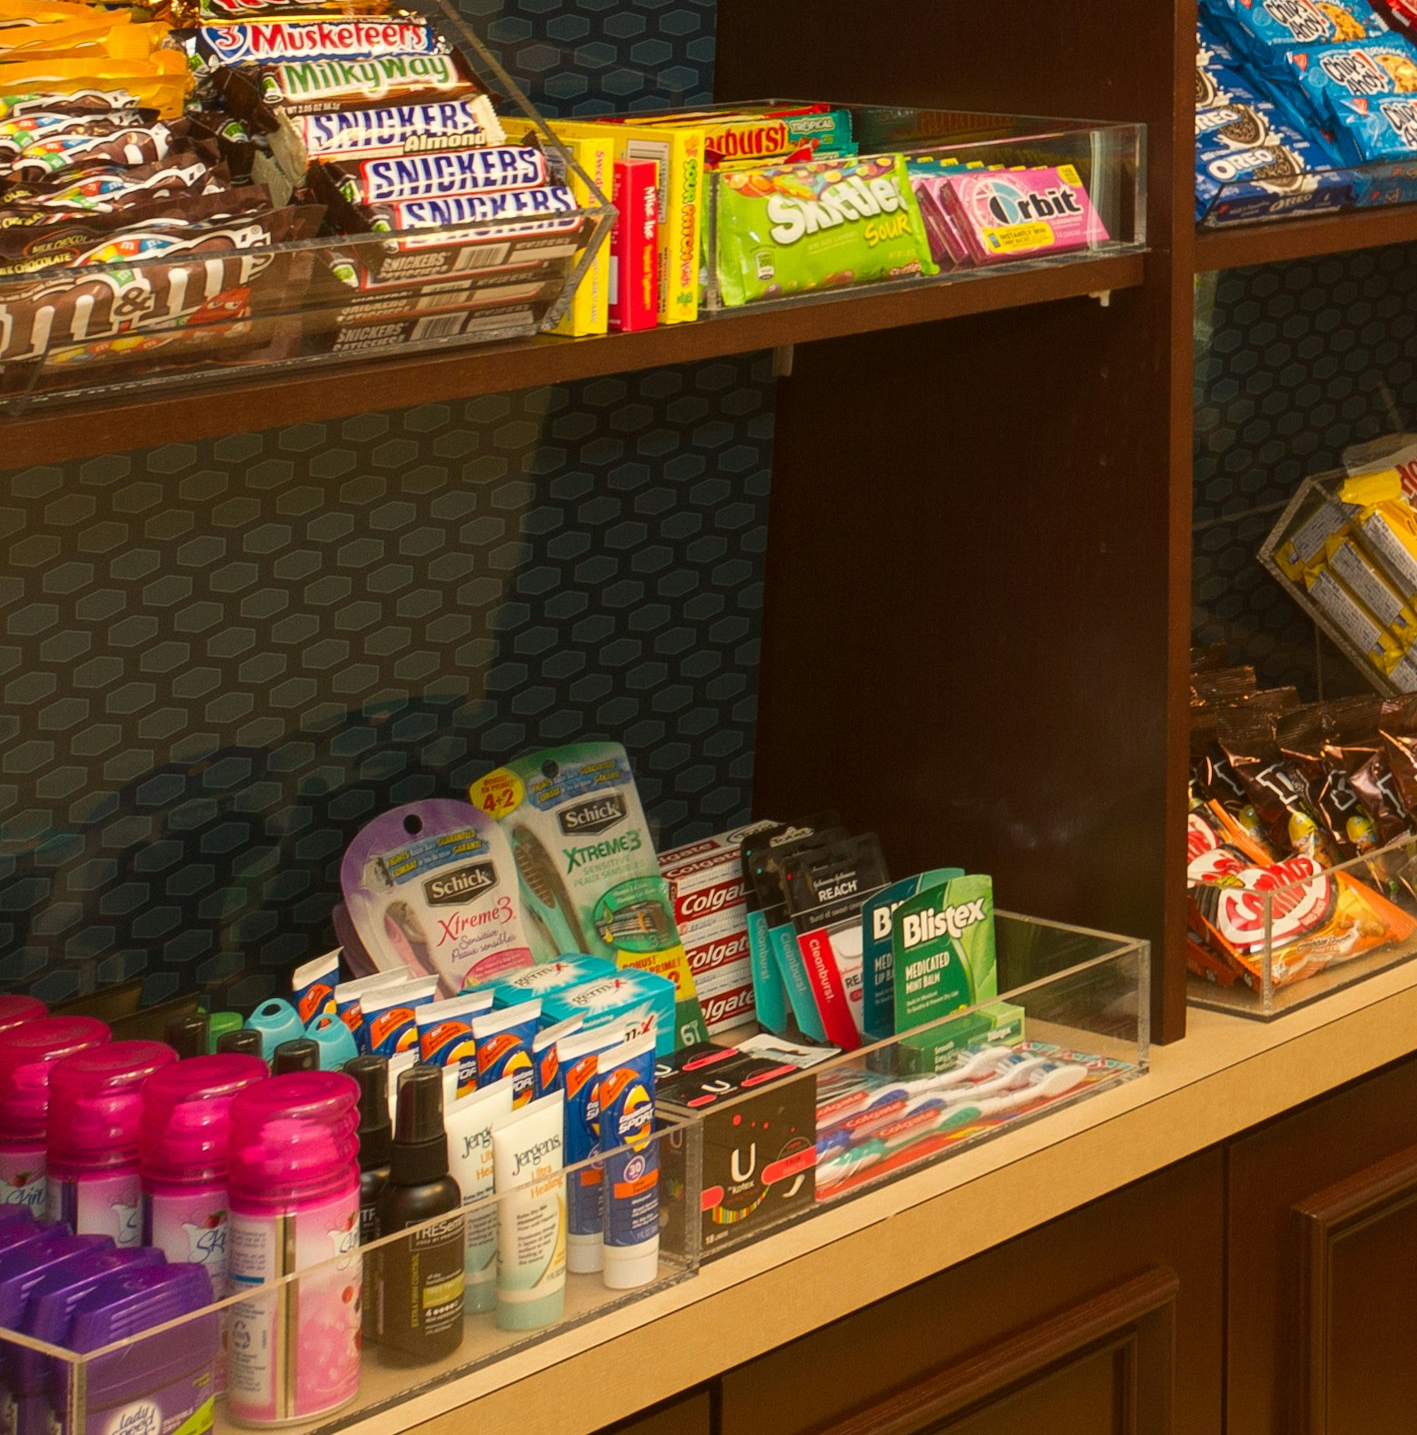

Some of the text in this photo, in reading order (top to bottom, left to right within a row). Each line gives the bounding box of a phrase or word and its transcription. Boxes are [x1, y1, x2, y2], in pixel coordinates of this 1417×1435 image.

[216, 23, 425, 53] 3 Musketeers
[285, 61, 382, 97] Milky
[403, 130, 487, 153] Almond
[372, 149, 540, 201] SNICKERS
[1208, 148, 1274, 180] OREO
[989, 188, 1081, 224] Orbit
[564, 801, 621, 828] Schick
[431, 863, 493, 896] Schick
[818, 881, 857, 902] REACH
[903, 898, 985, 948] Blistex
[905, 951, 950, 981] MEDICATED
[906, 973, 940, 995] MINT BALM
[512, 1134, 561, 1176] Jergens
